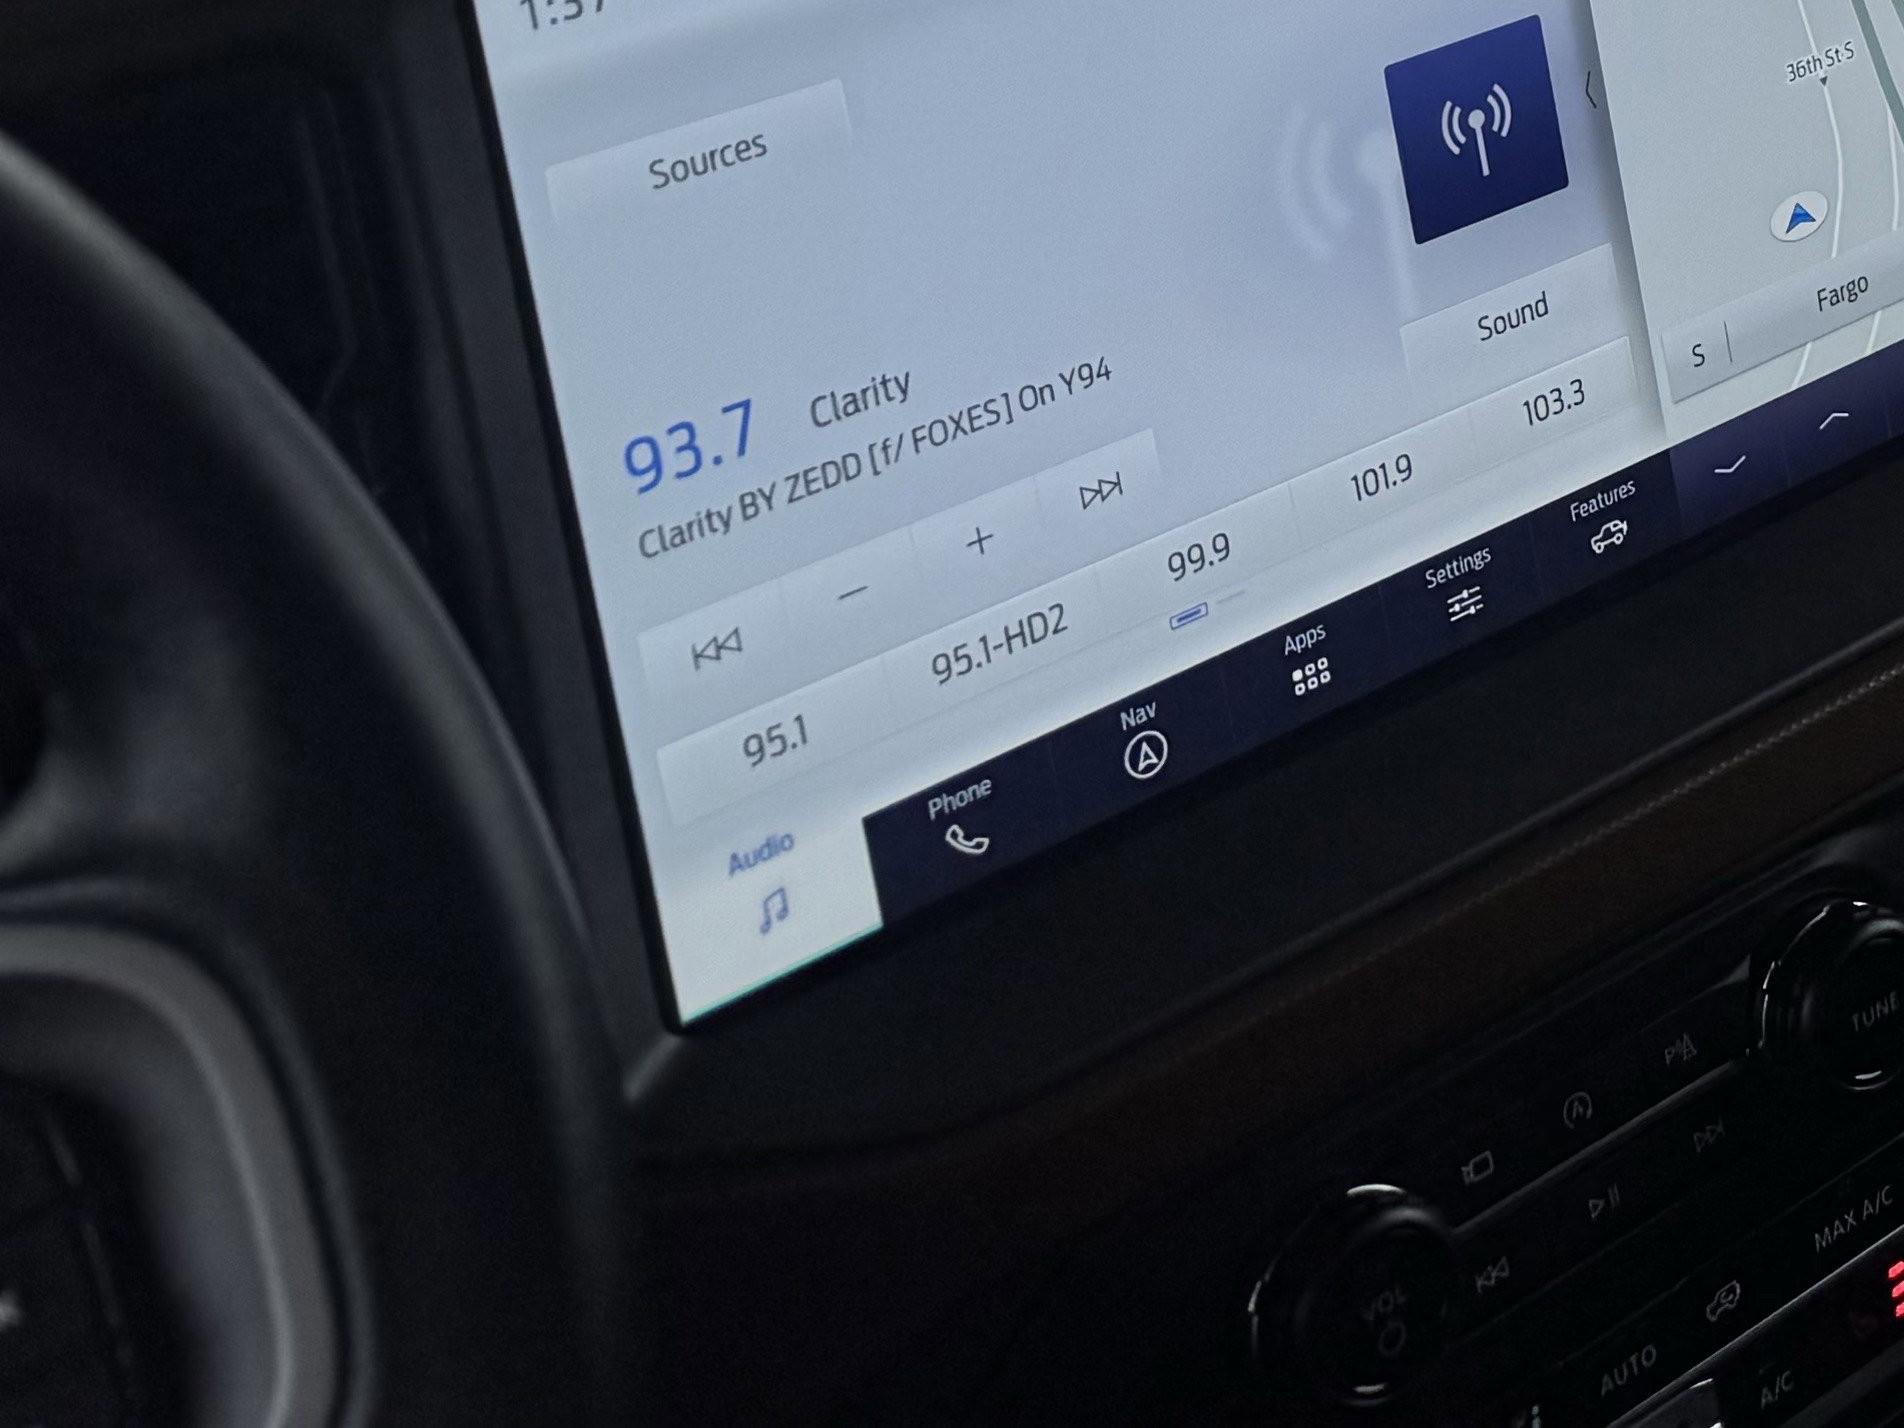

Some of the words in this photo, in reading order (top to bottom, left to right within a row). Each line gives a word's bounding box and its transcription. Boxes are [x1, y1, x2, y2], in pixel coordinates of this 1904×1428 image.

[1786, 55, 1823, 82] 36th
[1825, 47, 1841, 67] St
[1844, 40, 1854, 60] S
[648, 132, 768, 190] Sources
[1816, 273, 1870, 313] Fargo
[1477, 291, 1549, 343] Sound
[1692, 342, 1706, 369] S
[810, 370, 911, 429] Clarity
[623, 398, 755, 495] 93.7
[638, 501, 734, 560] Clarity
[738, 481, 778, 524] BY
[783, 451, 863, 505] ZEDD
[910, 390, 1015, 456] FOXES]
[1018, 379, 1056, 412] On
[1058, 355, 1113, 398] Y94
[1569, 478, 1636, 524] Features
[742, 713, 808, 768] 95.1
[931, 603, 1069, 685] 95.1-HD2
[1167, 531, 1232, 582] 99.9
[1350, 453, 1414, 502] 101.9
[1522, 378, 1586, 427] 103.3
[1425, 545, 1493, 590] Settings
[1284, 621, 1327, 657] Apps
[1119, 699, 1158, 731] Nav
[928, 775, 993, 820] Phone
[727, 830, 796, 878] Audio
[1851, 990, 1900, 1031] TUNE
[1813, 1208, 1859, 1254] MAX
[1861, 1184, 1895, 1222] A/C
[1600, 1343, 1658, 1399] AUTO
[1759, 1369, 1797, 1410] A/C
